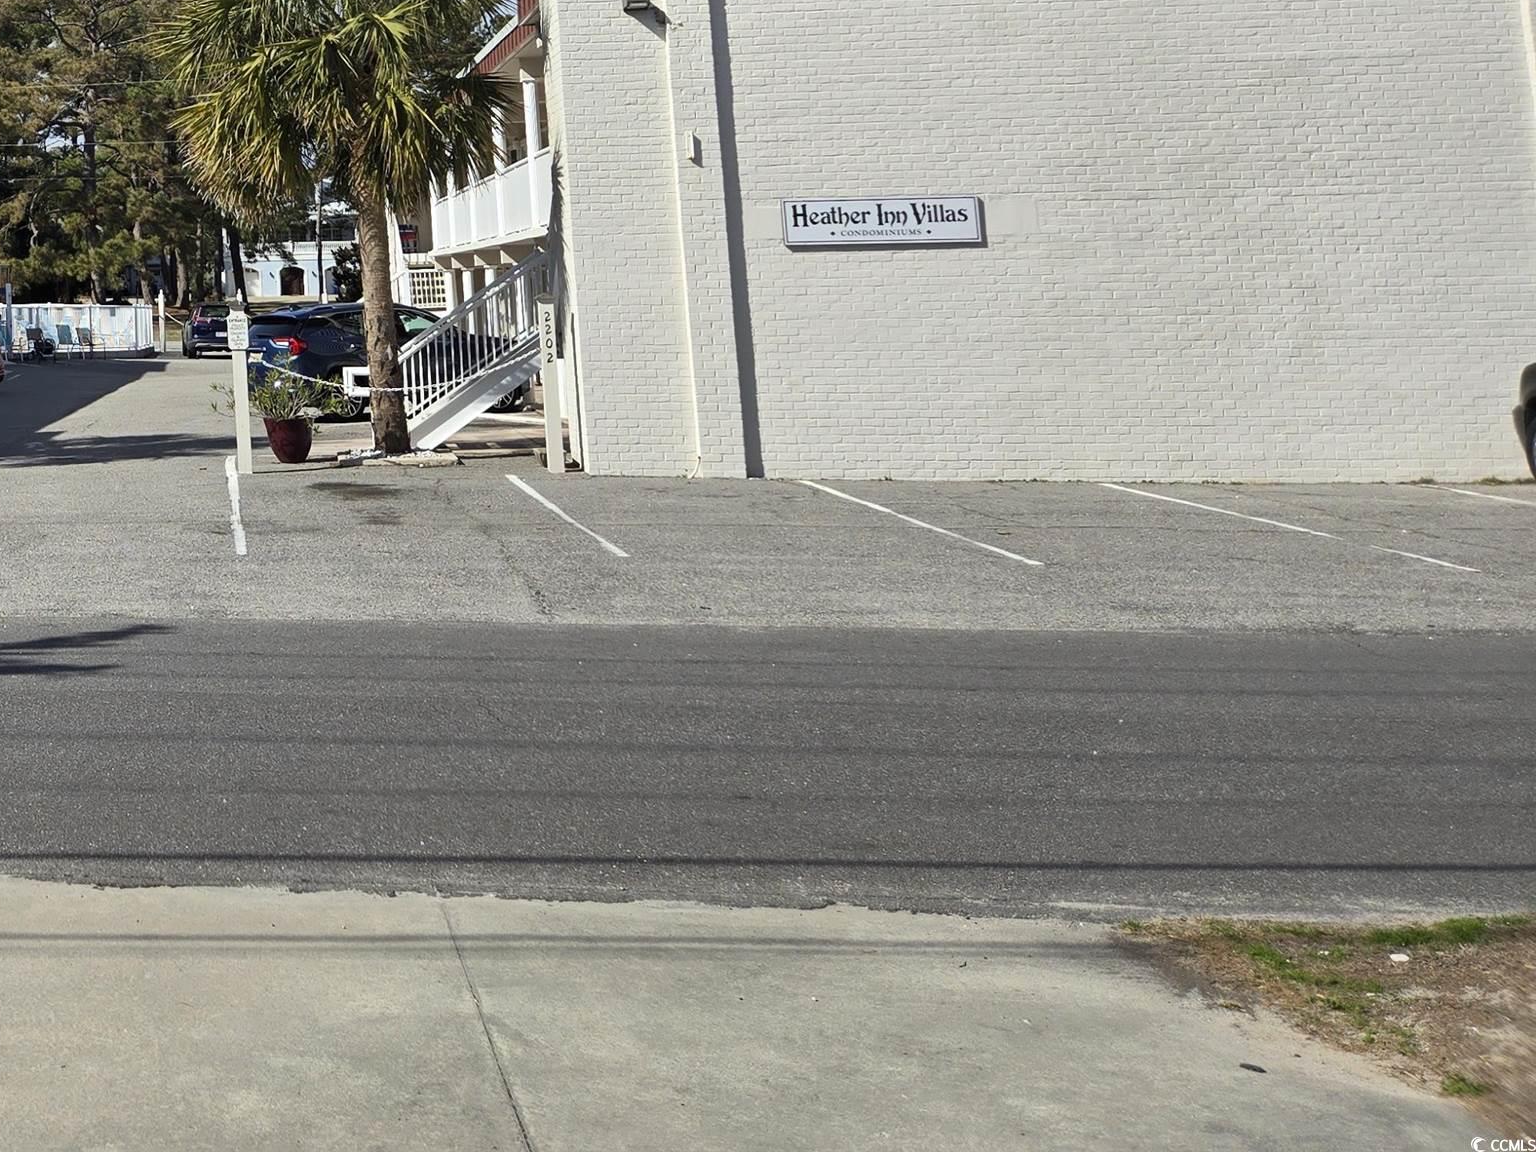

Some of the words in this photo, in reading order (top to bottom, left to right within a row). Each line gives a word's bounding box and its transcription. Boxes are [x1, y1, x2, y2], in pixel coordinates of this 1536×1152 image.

[791, 203, 871, 228] Heather
[875, 203, 908, 227] Inn
[909, 202, 969, 225] Villas
[840, 228, 922, 237] CONDOMINIUMS
[544, 311, 554, 364] 2202
